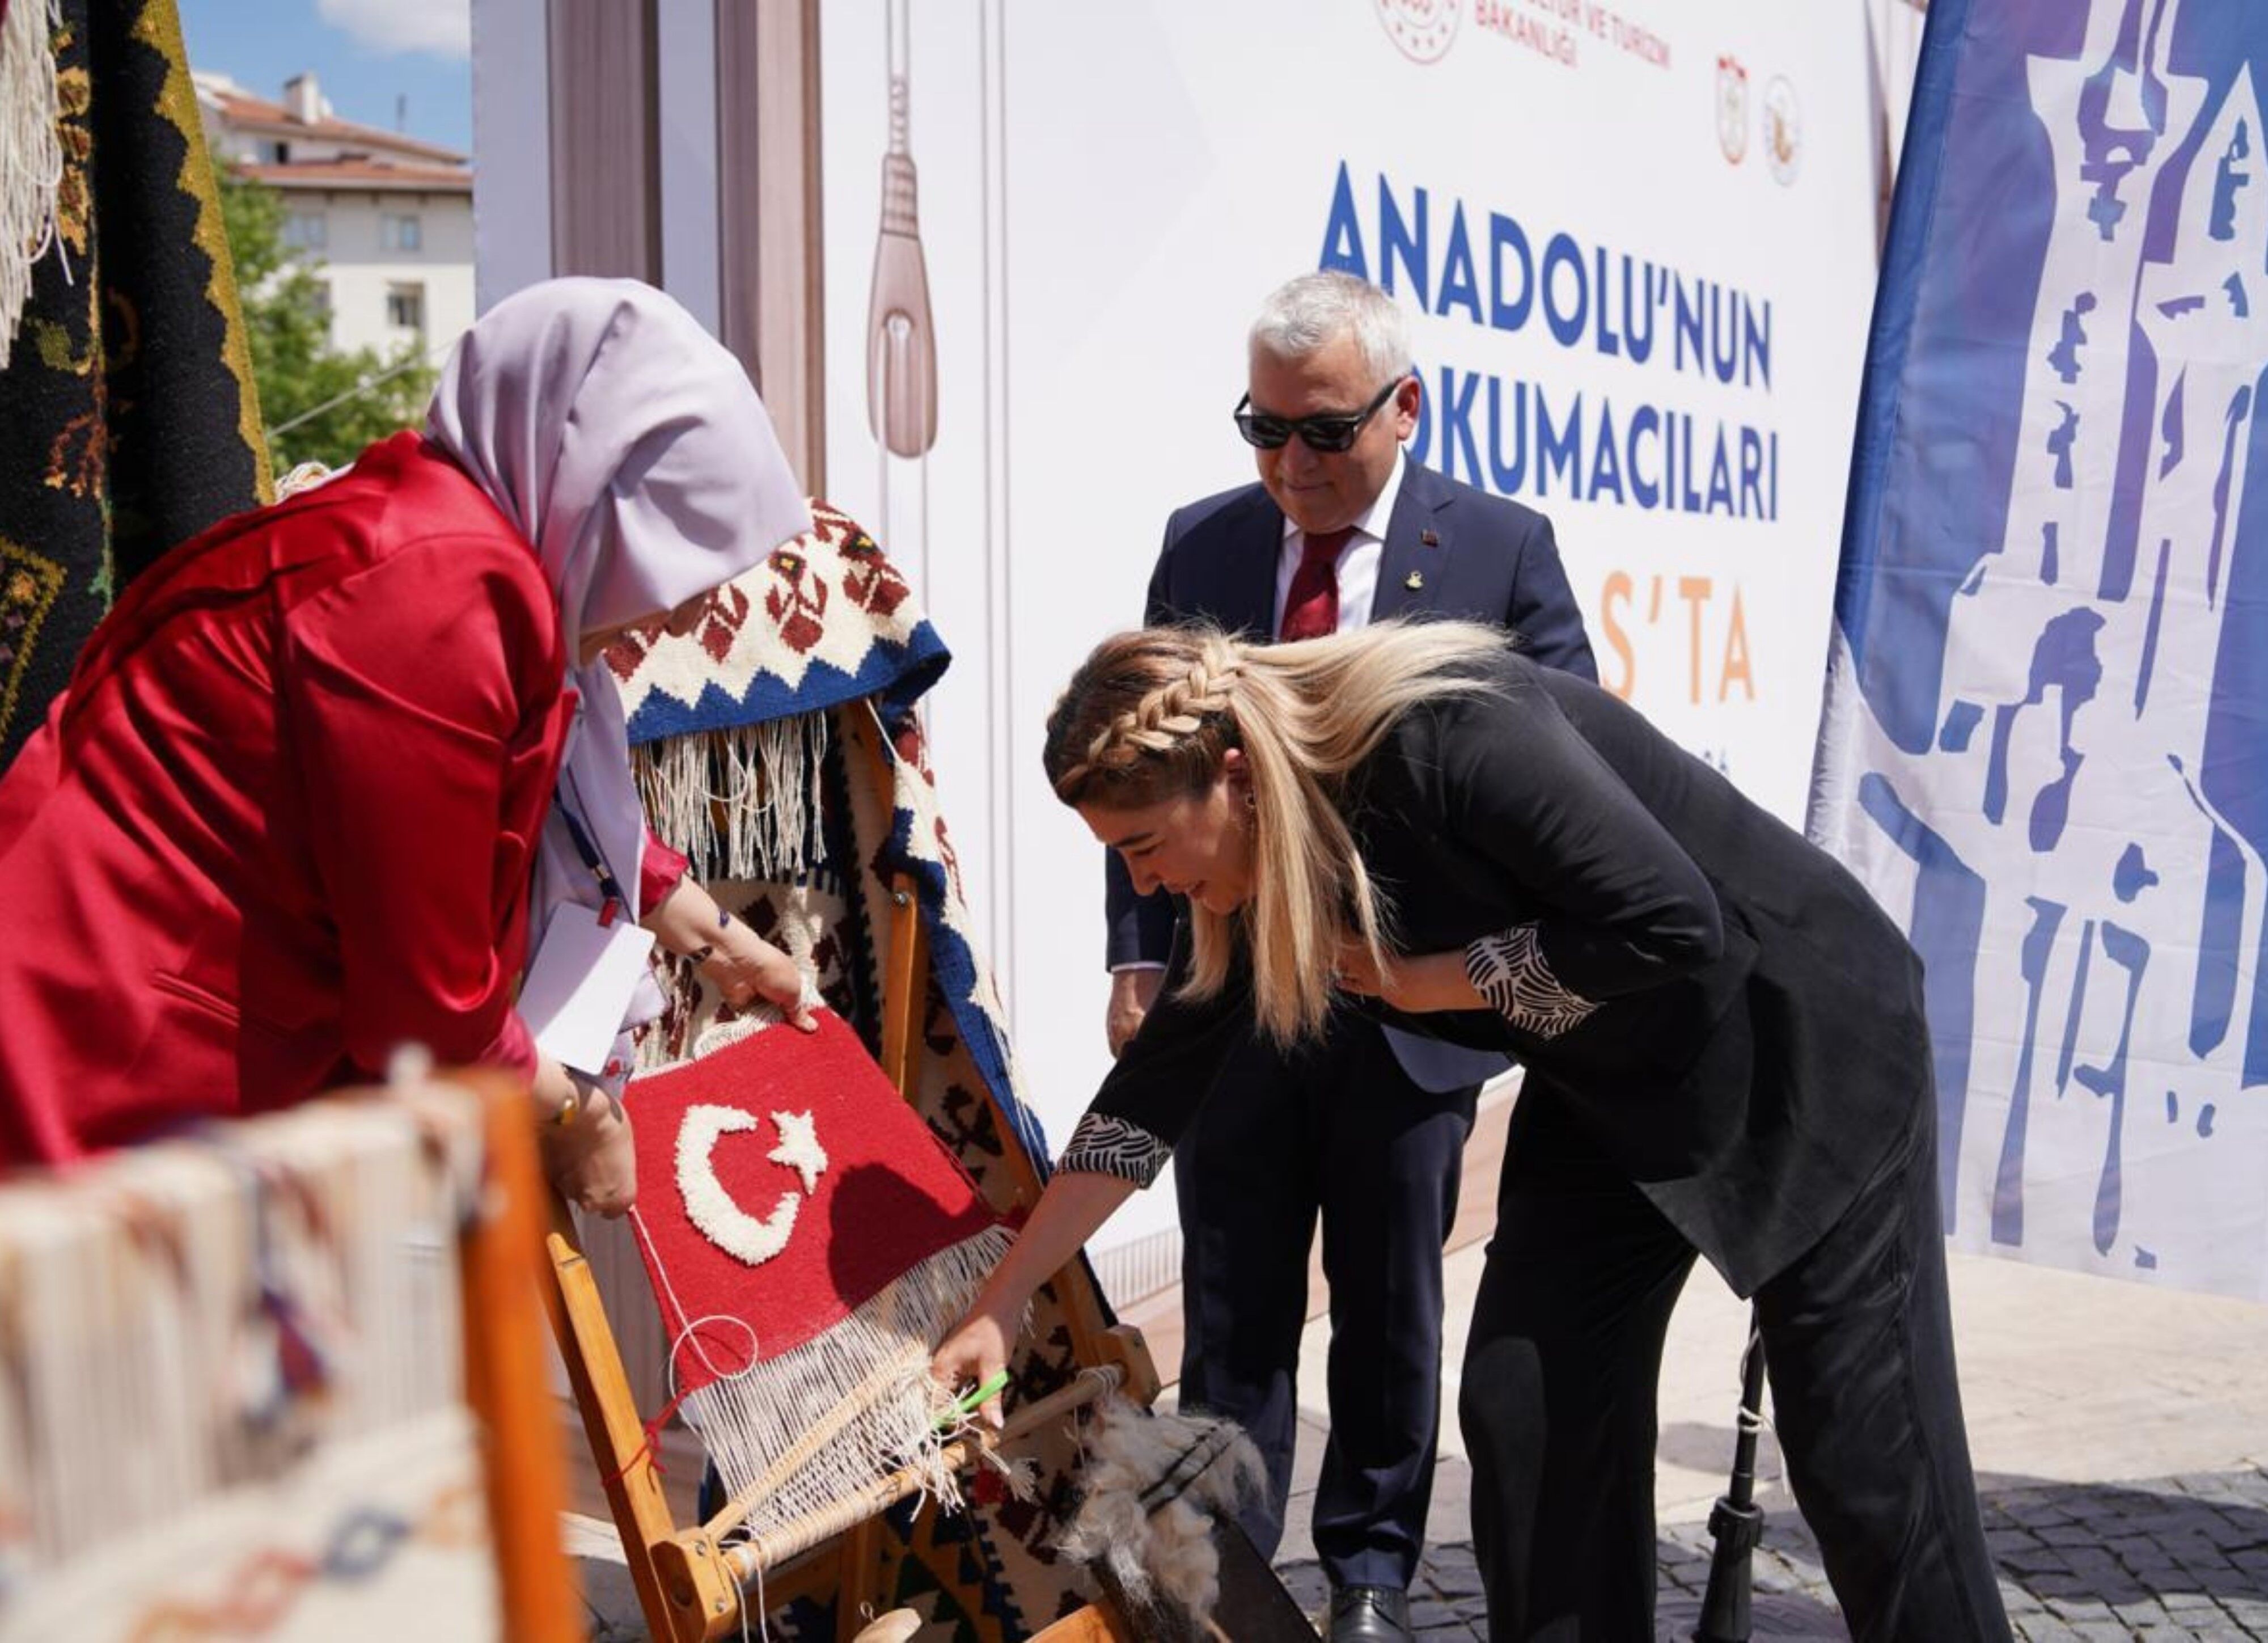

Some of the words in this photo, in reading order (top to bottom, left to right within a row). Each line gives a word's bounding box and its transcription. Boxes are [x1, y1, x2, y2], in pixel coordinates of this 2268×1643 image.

[1586, 5, 1607, 39] VE
[1319, 159, 1771, 391] ANADOLU'NUN
[1410, 364, 1777, 521] KUMACILARI
[1600, 570, 1755, 705] S'TA
